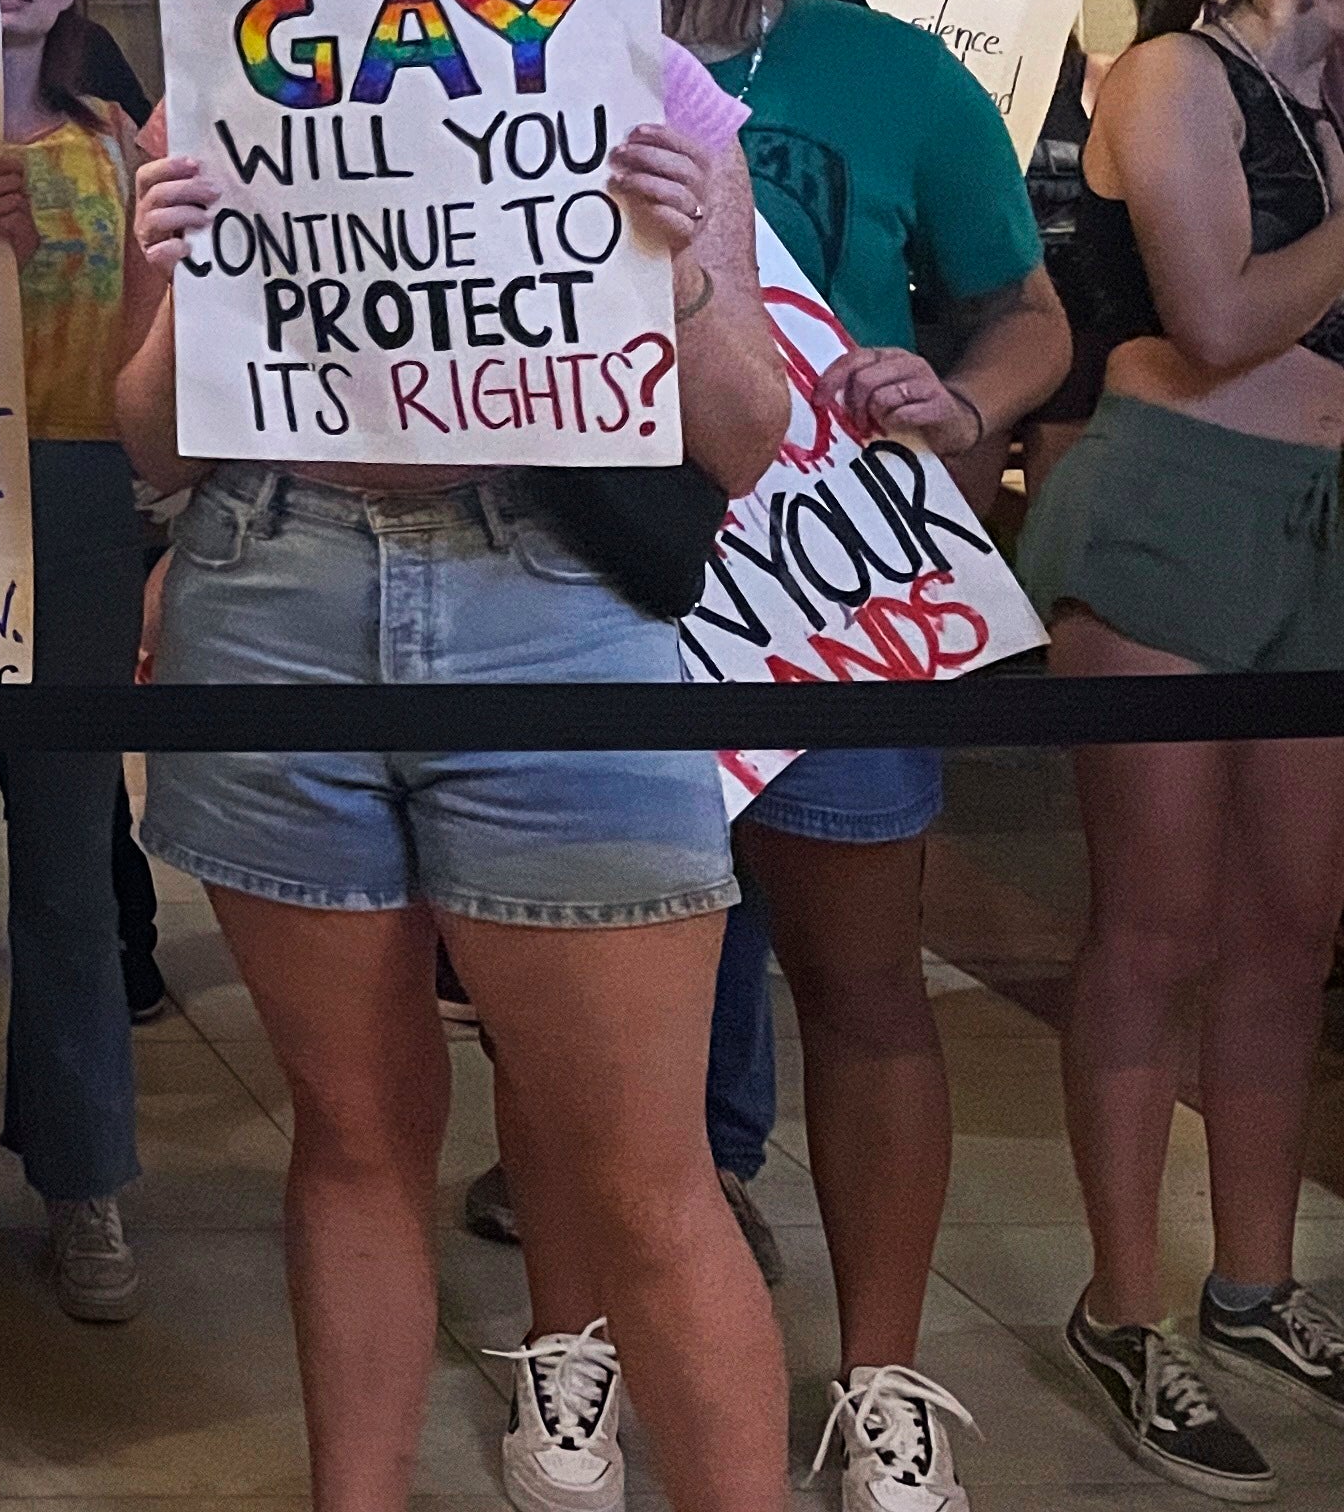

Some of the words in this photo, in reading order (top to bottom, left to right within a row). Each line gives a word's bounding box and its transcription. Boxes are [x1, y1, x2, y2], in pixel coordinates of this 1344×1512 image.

[214, 114, 414, 186] WILL
[442, 104, 607, 185] YOU
[501, 190, 623, 265] TO
[263, 271, 594, 353] PROTECT
[390, 332, 677, 437] RIGHTS?
[721, 440, 993, 631] YOUR
[677, 555, 772, 682] N
